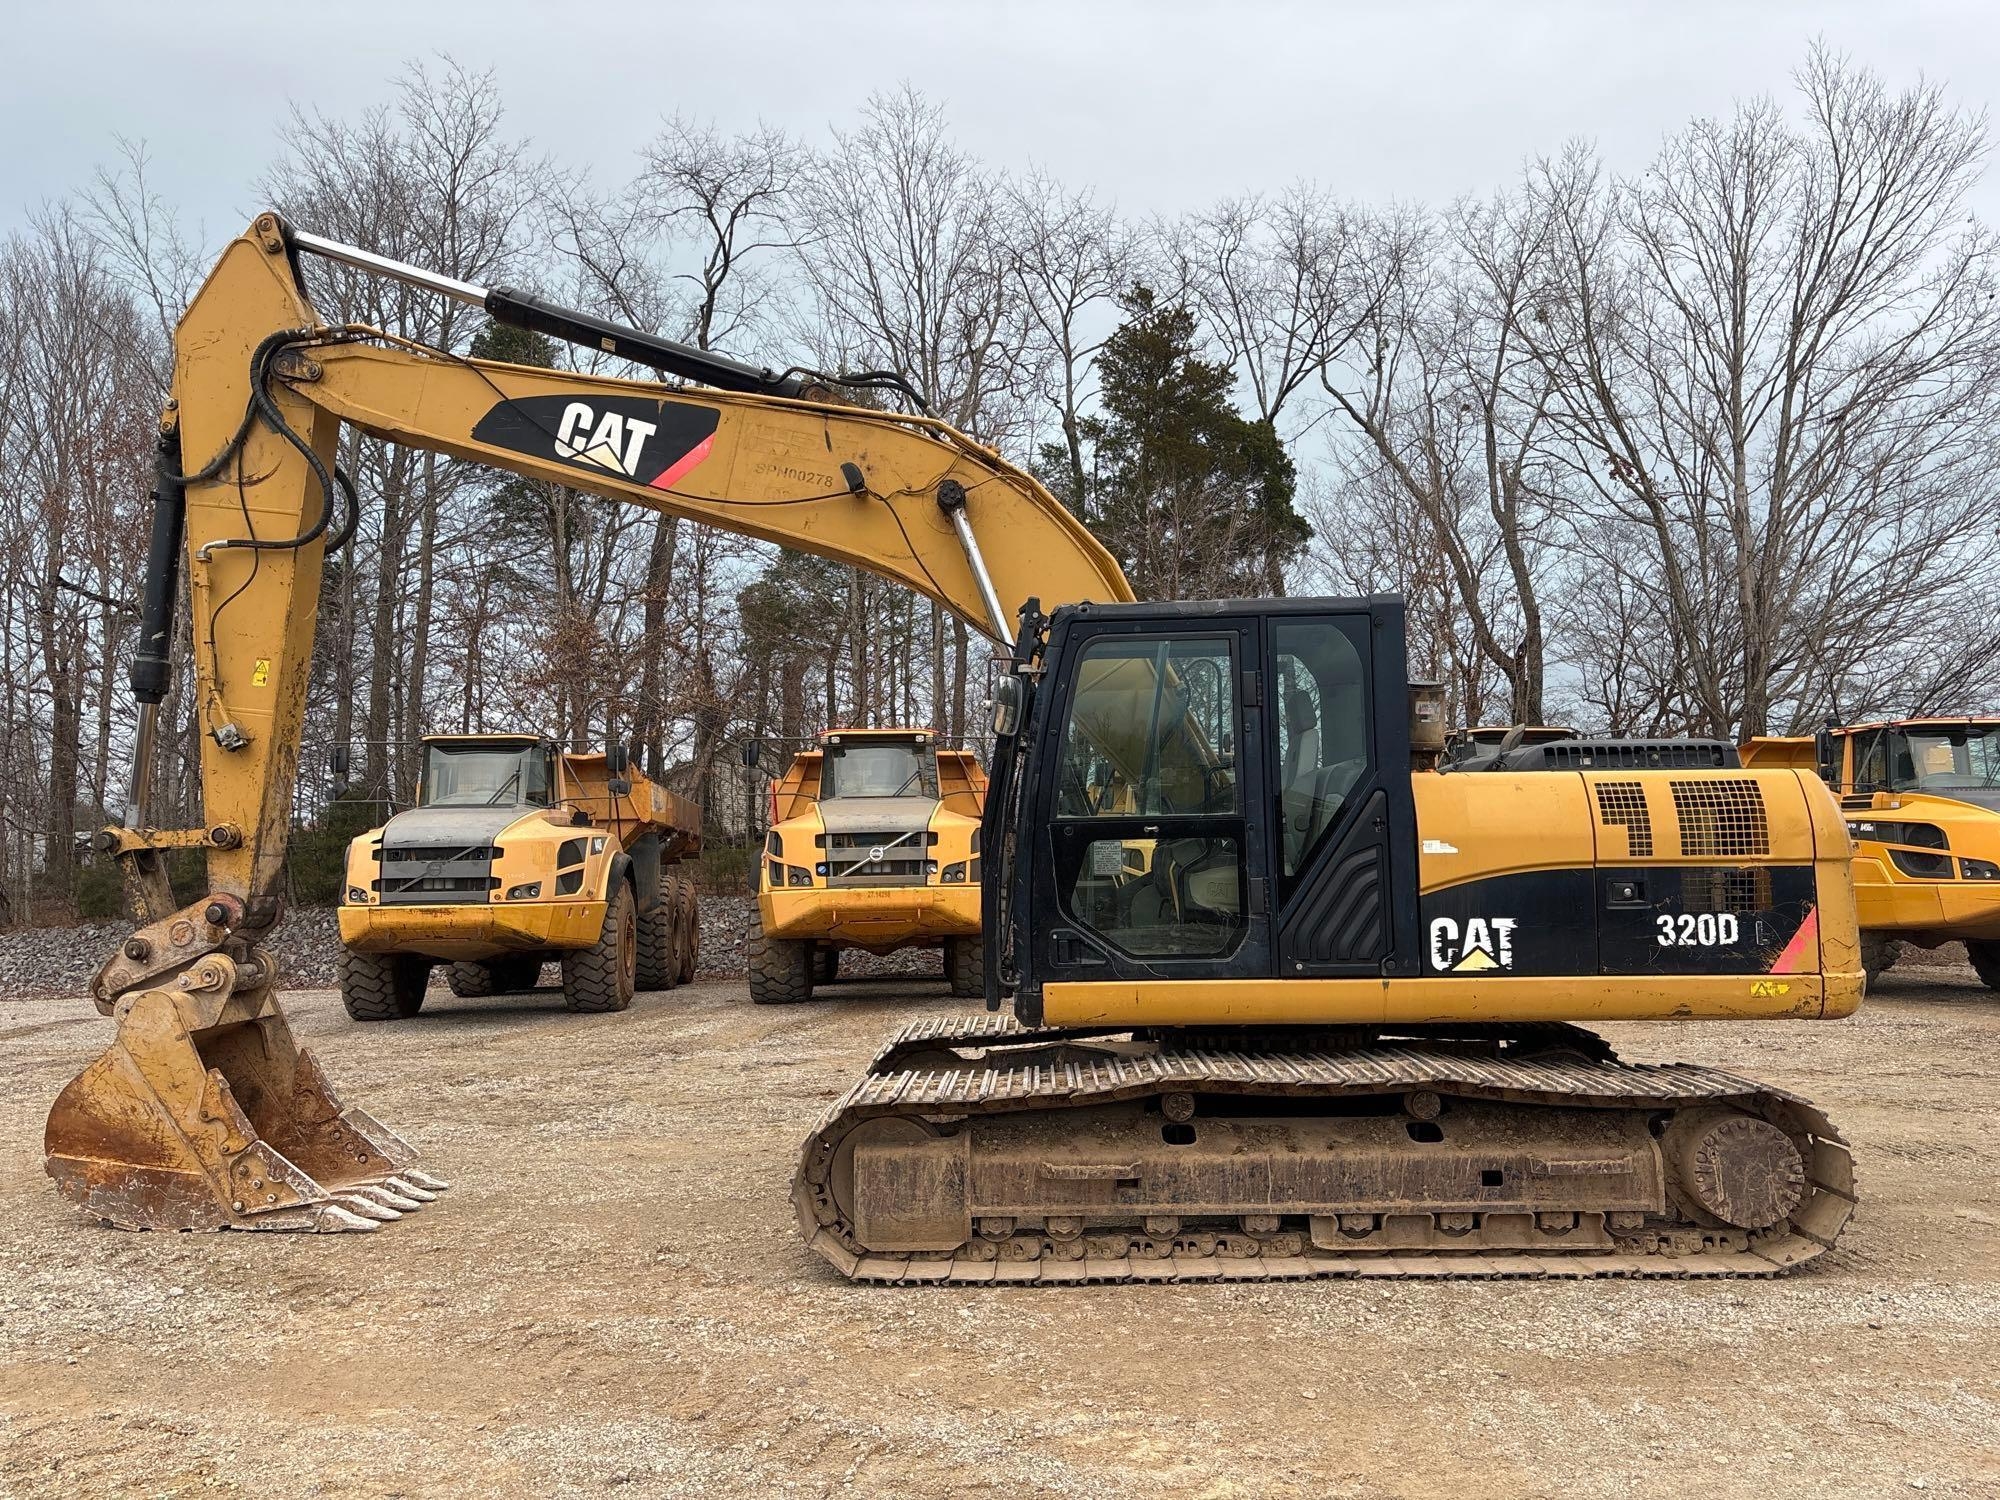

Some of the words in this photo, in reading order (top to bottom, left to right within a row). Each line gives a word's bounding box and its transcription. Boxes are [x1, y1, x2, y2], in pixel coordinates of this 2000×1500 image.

[554, 402, 657, 477] CAT
[1430, 917, 1518, 971] CAT
[1656, 913, 1739, 946] 320D
